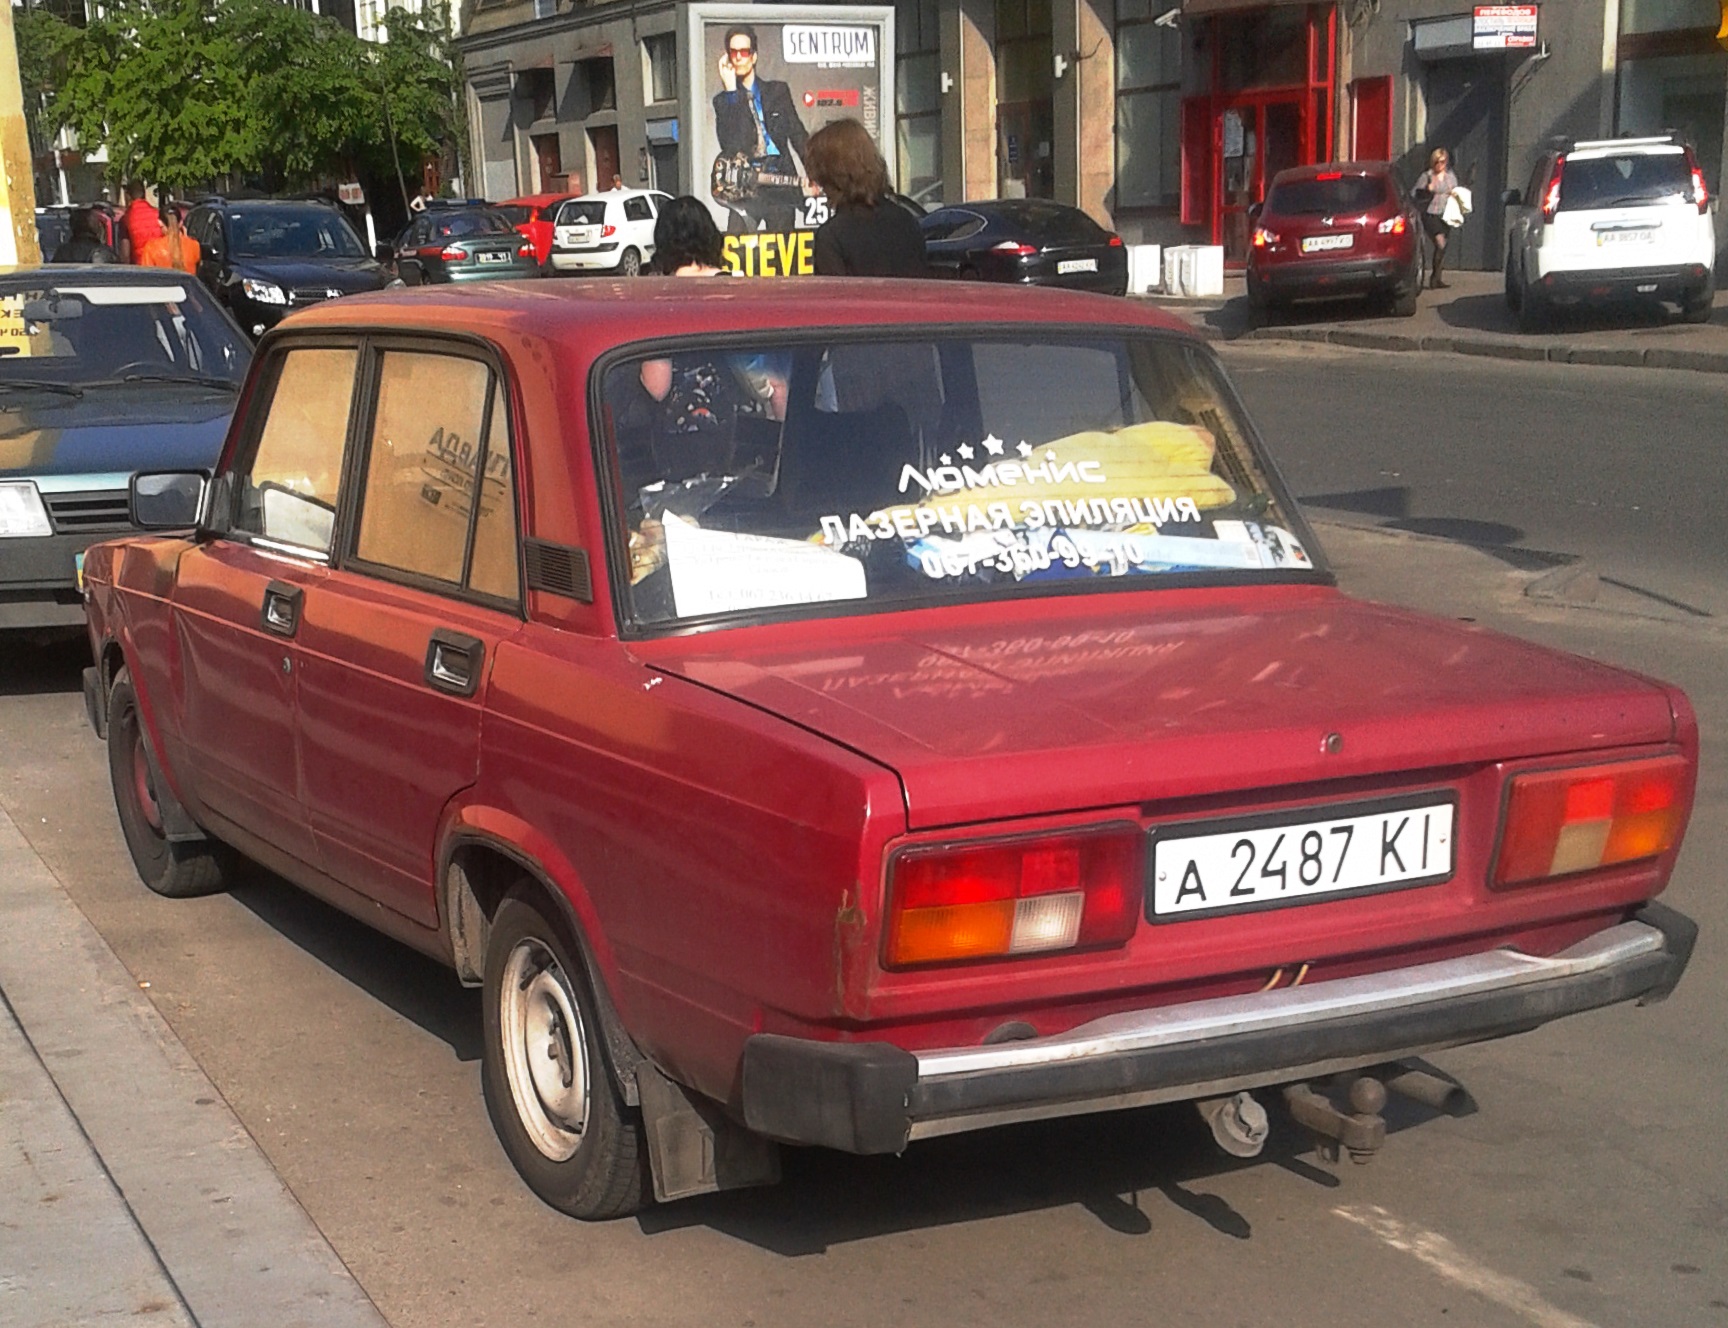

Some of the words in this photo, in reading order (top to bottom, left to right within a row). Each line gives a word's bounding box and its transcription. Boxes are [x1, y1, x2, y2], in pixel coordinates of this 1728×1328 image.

[790, 31, 869, 58] SENTRUM
[805, 196, 829, 225] 25
[722, 231, 815, 277] STEVE
[819, 503, 1017, 545] ЛАЗЕРНАЯ
[1019, 496, 1202, 528] ЭПИЛЯЦИЯ
[1174, 859, 1208, 905] A
[1229, 825, 1355, 897] 2487
[1380, 814, 1431, 876] KI
